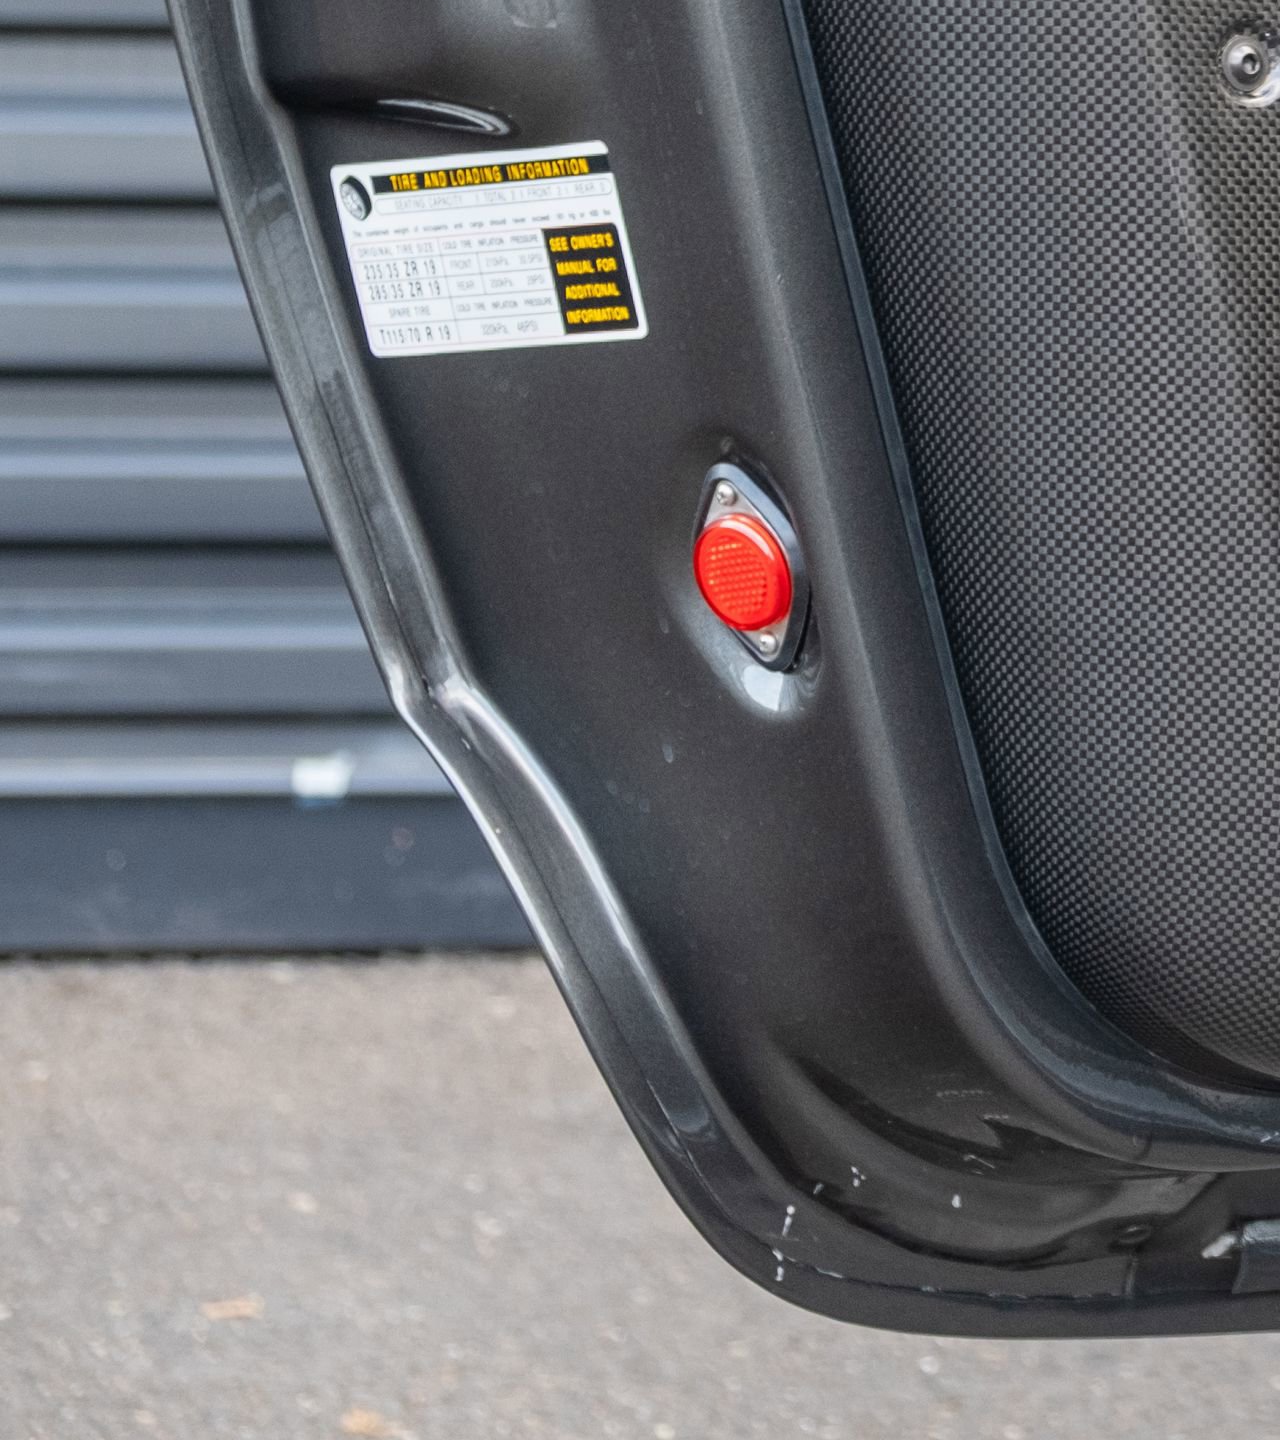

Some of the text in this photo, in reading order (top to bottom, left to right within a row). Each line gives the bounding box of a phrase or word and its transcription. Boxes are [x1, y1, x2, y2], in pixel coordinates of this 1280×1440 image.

[390, 157, 590, 192] TIRE AND LOADING INFORMATION
[549, 232, 614, 252] SEE OWNER'S
[403, 260, 419, 277] ZR
[423, 259, 436, 275] 19
[556, 257, 617, 276] MANUAL FOR
[408, 280, 424, 298] ZR
[428, 279, 441, 296] 19
[565, 282, 621, 300] ADDITIONAL
[566, 306, 630, 324] INFORMATION
[379, 323, 451, 345] T11570 R 19
